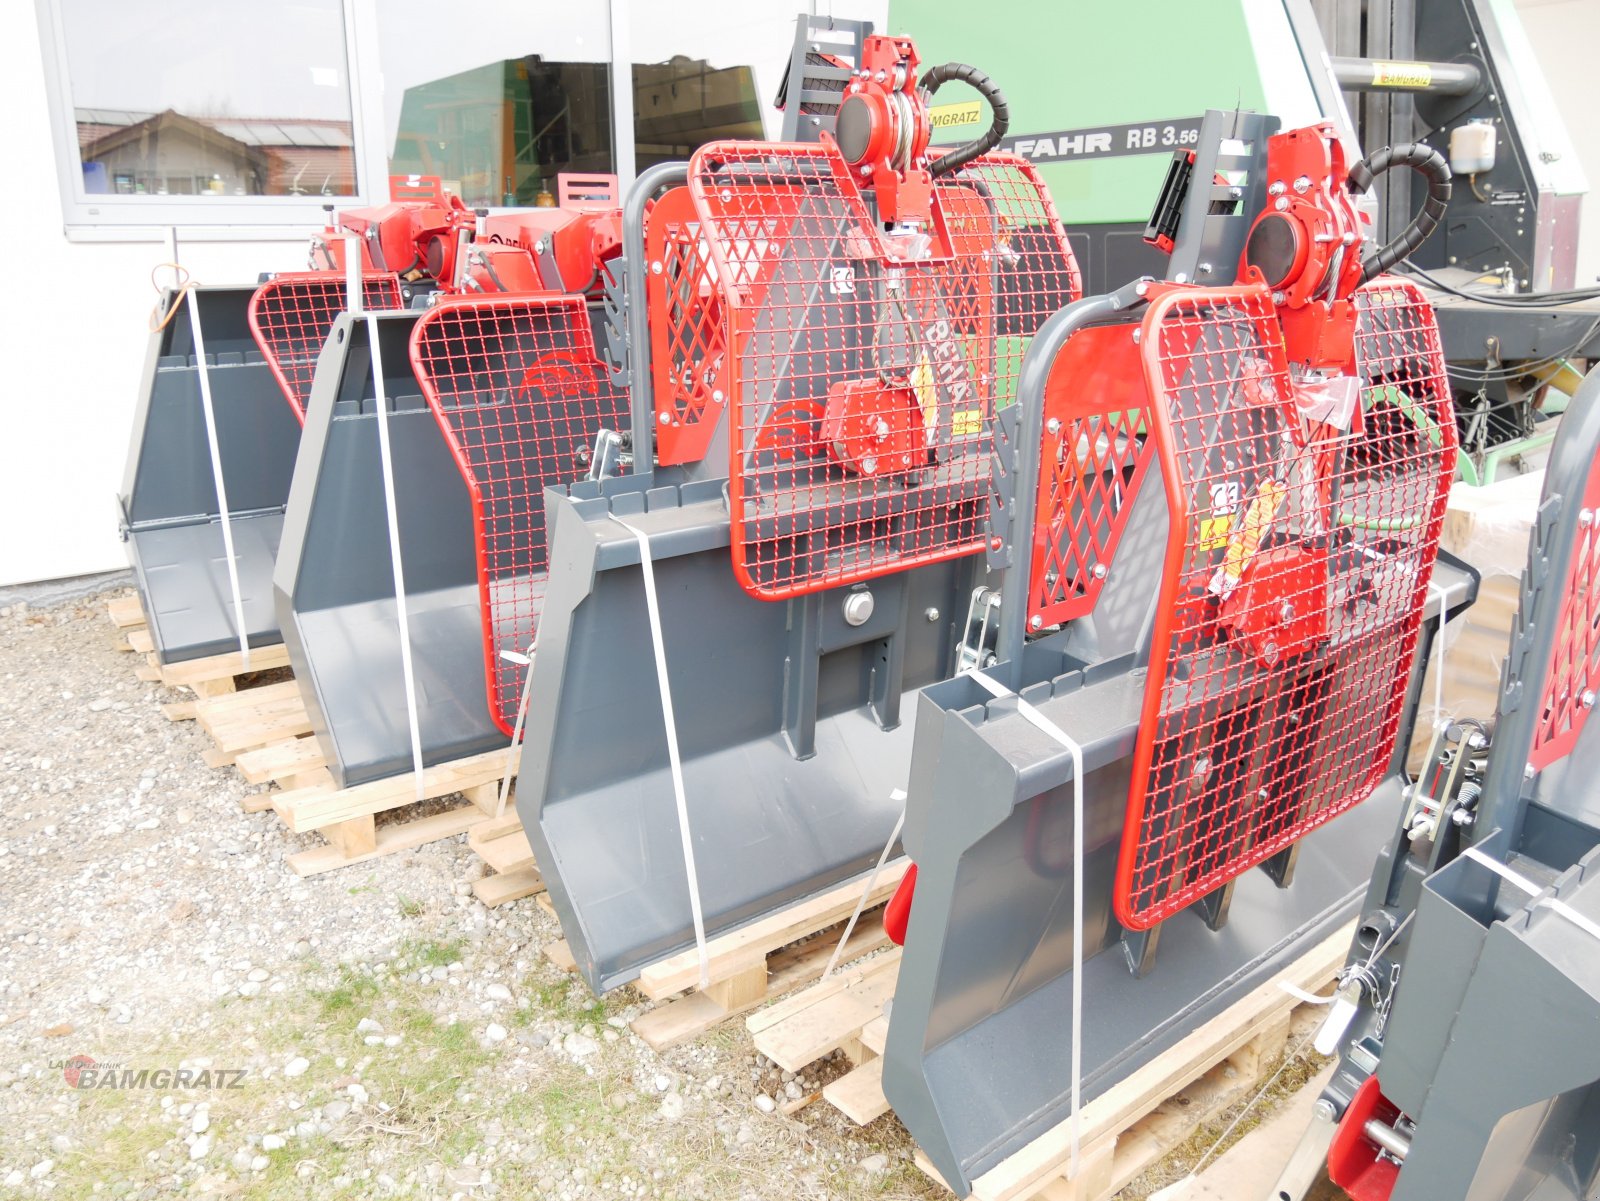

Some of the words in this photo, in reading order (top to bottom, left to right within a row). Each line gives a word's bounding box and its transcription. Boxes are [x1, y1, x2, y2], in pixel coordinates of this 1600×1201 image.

[929, 111, 979, 126] MGRATZ
[1126, 128, 1156, 149] RB
[1162, 126, 1198, 146] 3.56
